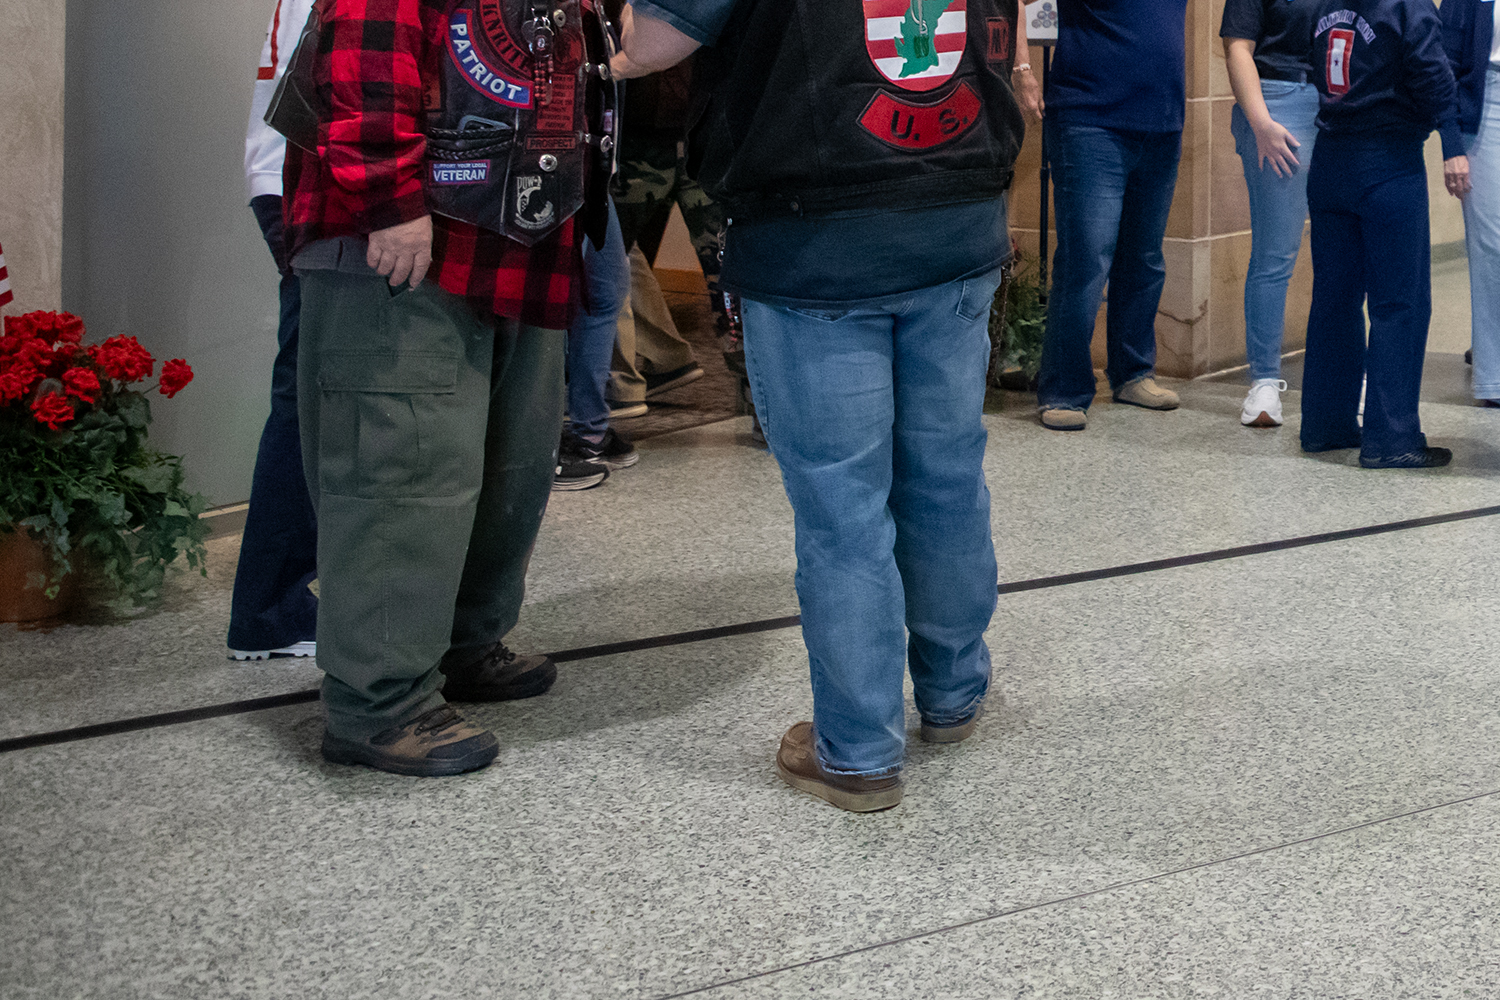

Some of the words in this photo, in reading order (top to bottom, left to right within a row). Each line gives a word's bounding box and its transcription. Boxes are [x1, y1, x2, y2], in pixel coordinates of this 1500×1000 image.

[450, 23, 523, 101] PATRIOT
[530, 138, 573, 148] PROSPECT
[433, 169, 486, 182] VETERAN
